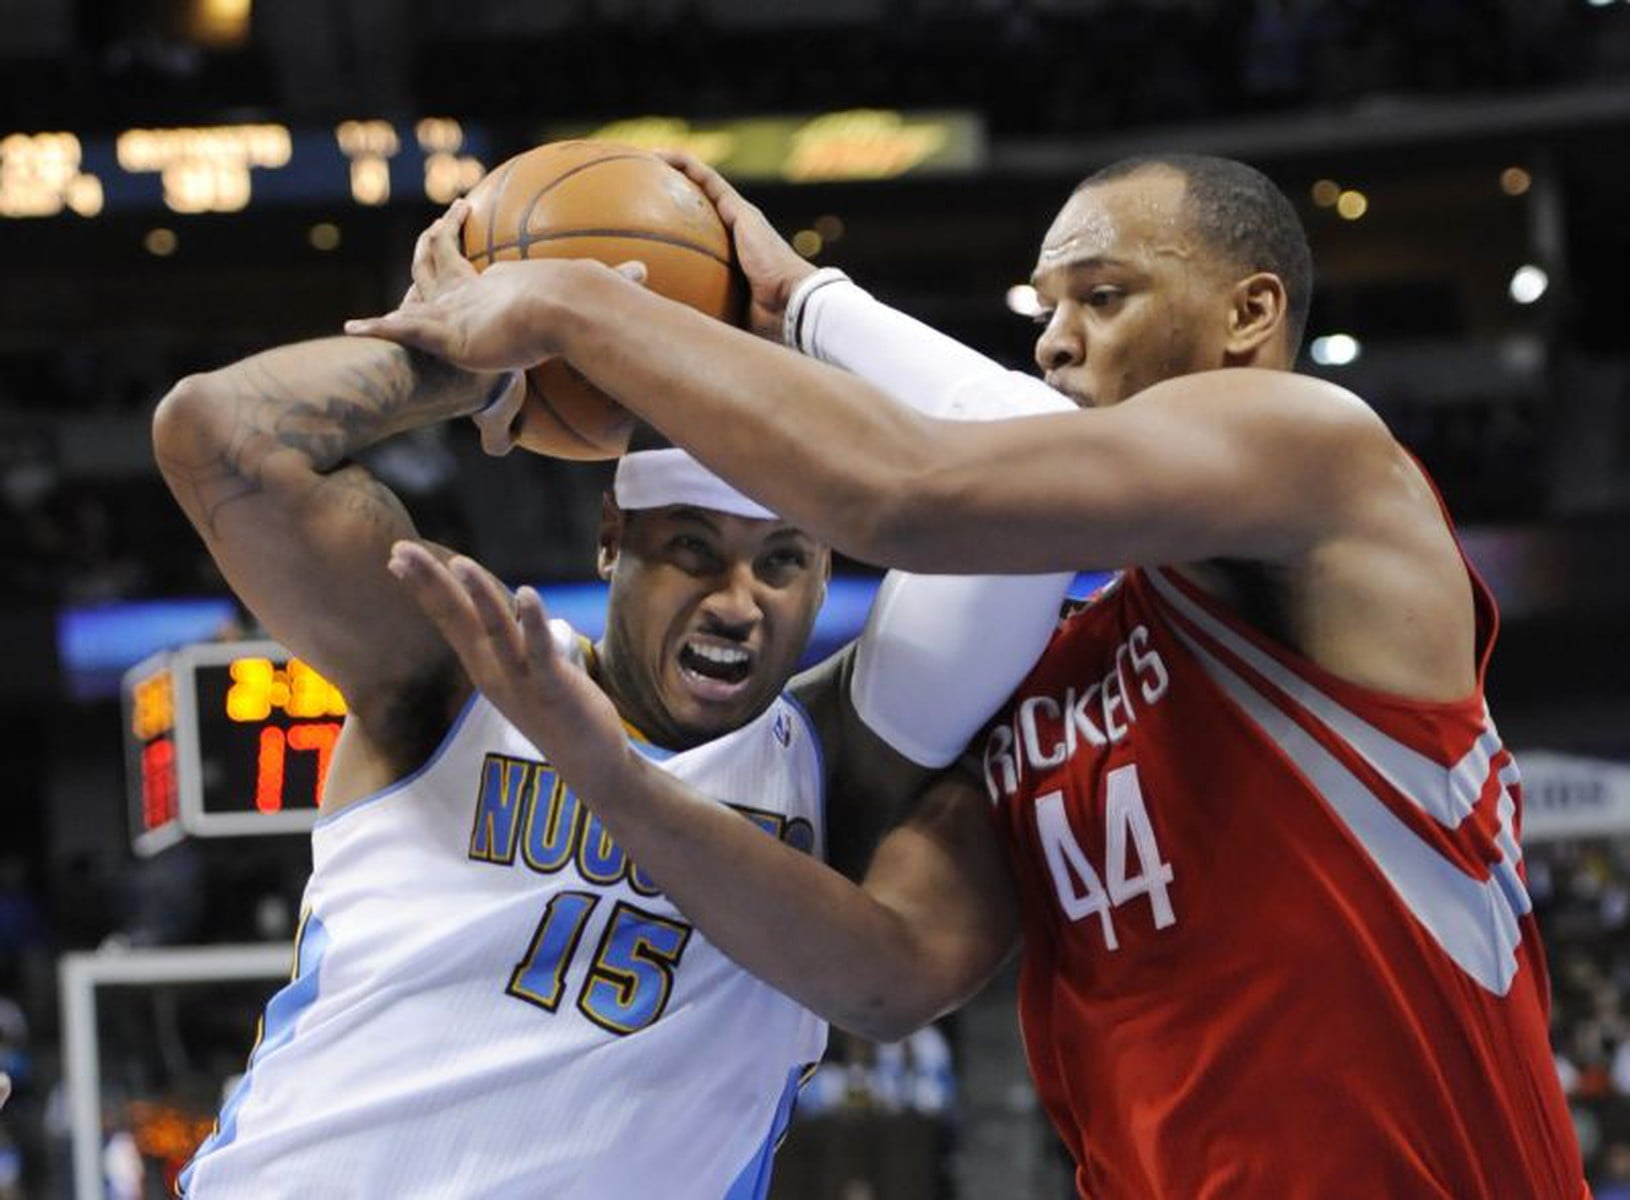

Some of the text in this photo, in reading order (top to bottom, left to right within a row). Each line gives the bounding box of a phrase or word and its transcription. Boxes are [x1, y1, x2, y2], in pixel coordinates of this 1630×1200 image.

[984, 625, 1169, 806] RCKETS
[1035, 763, 1176, 950] 44
[505, 891, 693, 1036] 15
